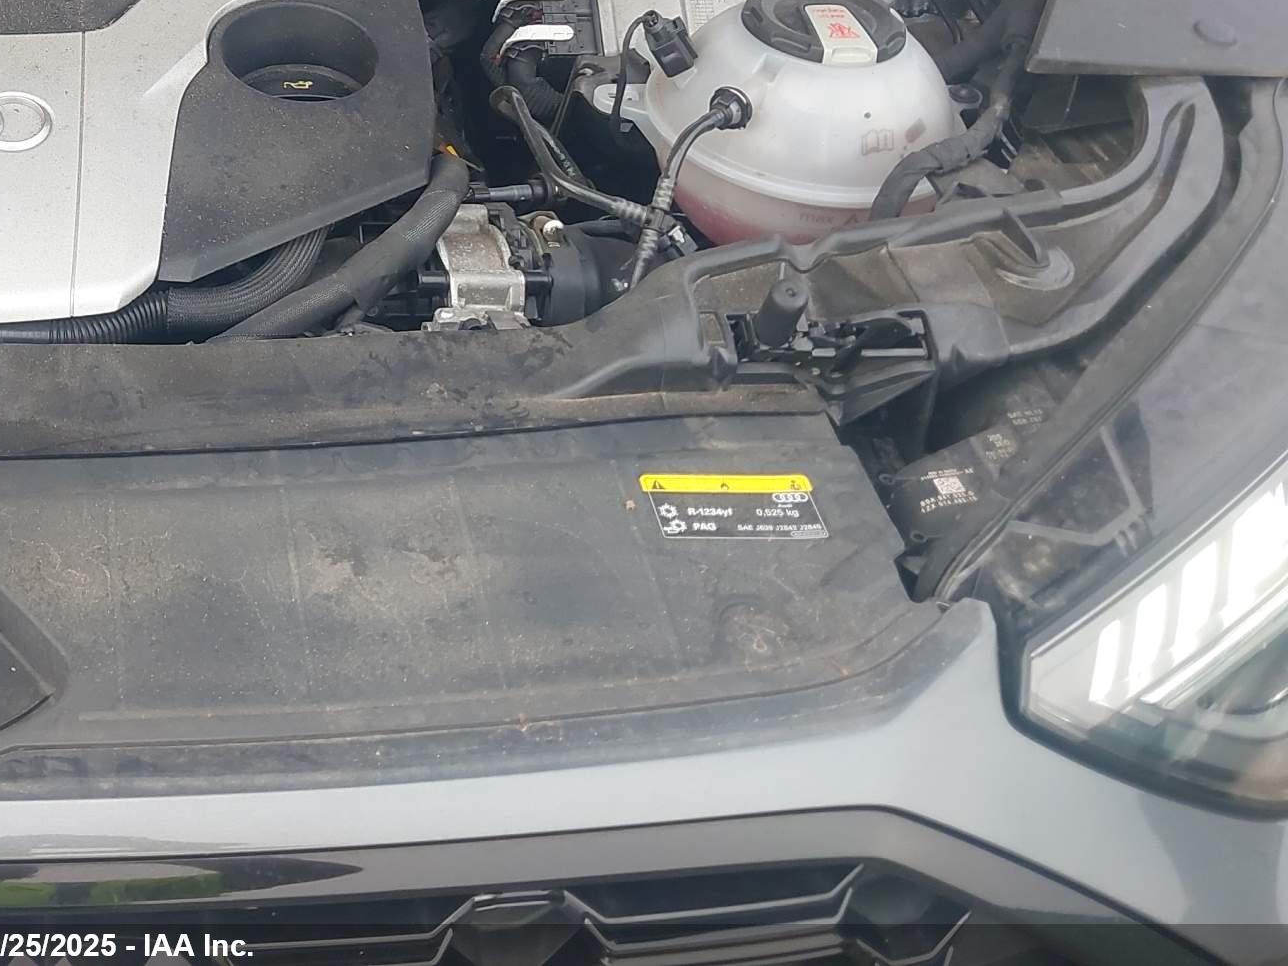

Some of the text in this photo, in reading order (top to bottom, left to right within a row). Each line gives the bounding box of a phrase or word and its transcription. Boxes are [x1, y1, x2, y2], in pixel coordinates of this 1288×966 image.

[687, 507, 733, 518] R-1234yf
[786, 508, 800, 518] kg
[692, 522, 717, 532] PAG
